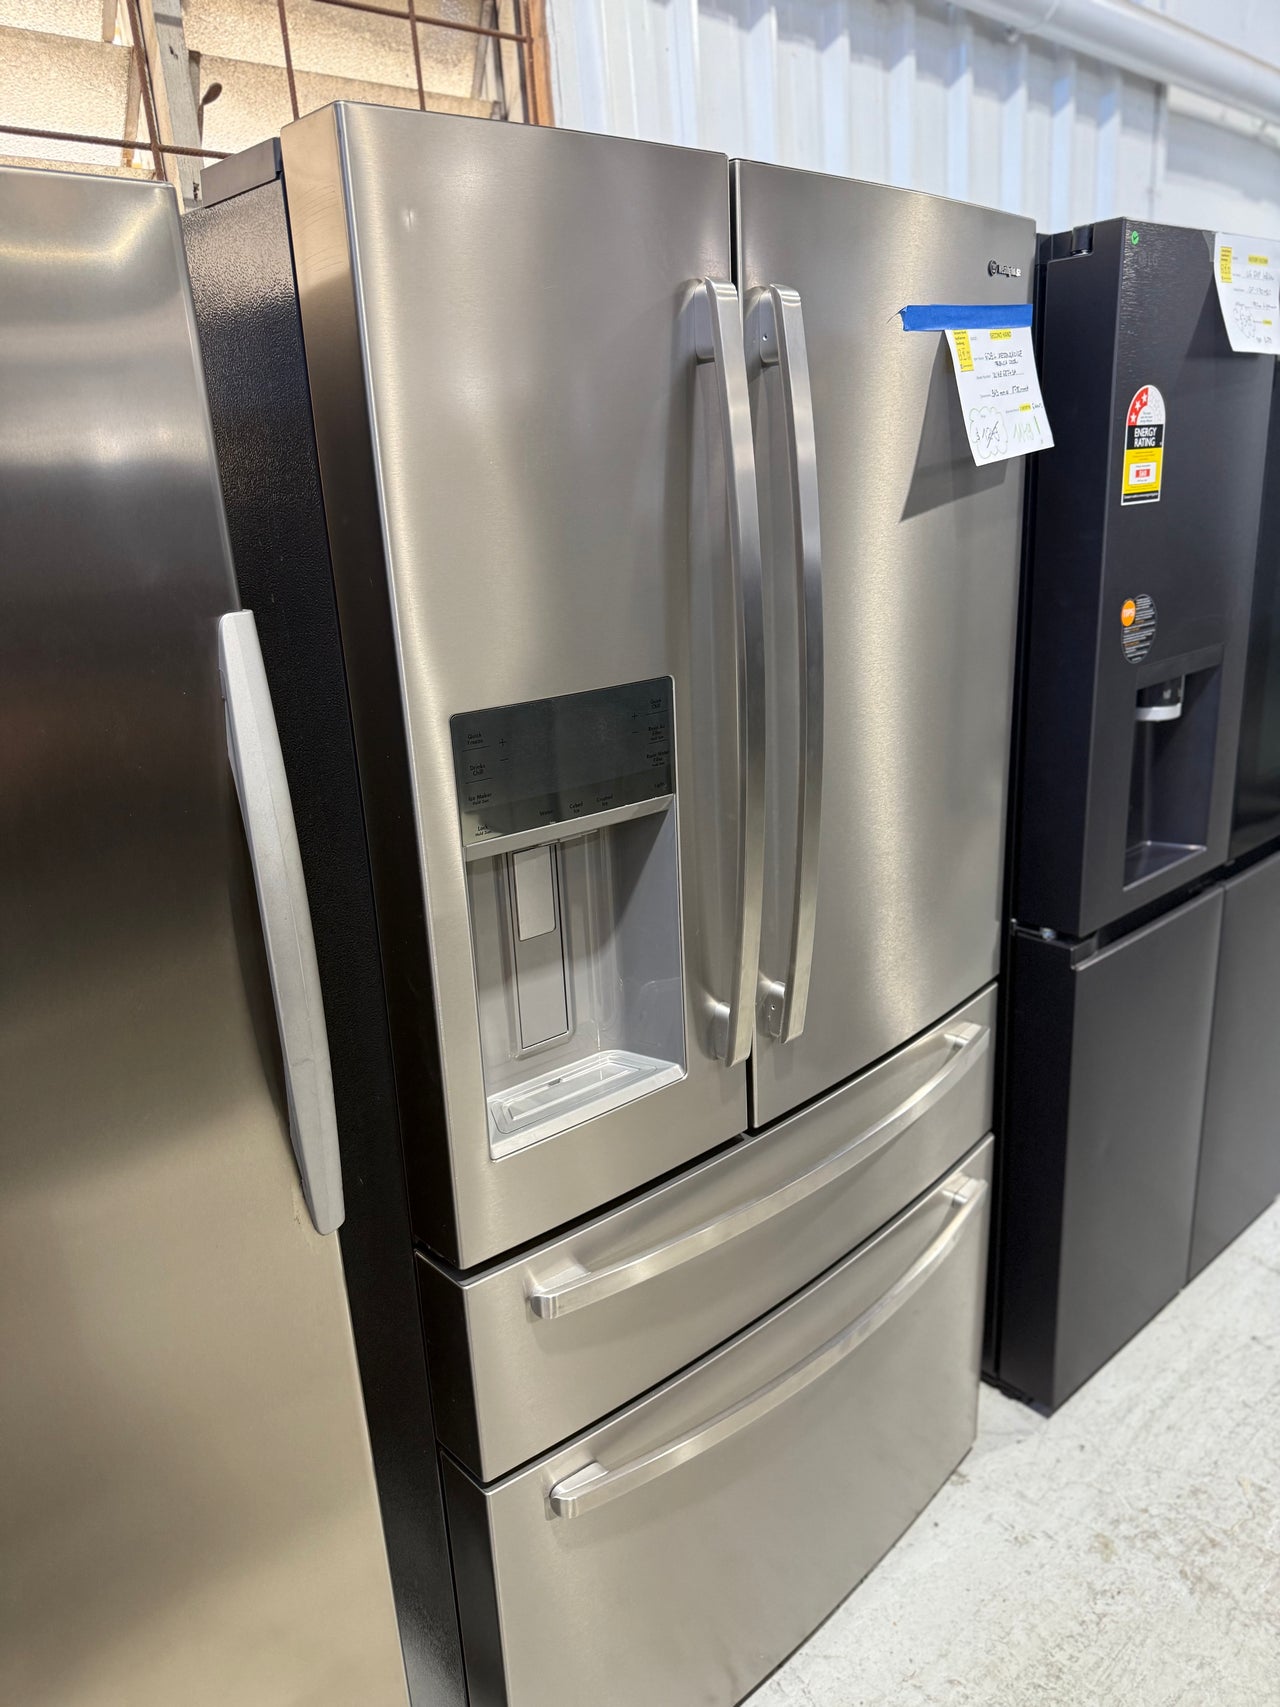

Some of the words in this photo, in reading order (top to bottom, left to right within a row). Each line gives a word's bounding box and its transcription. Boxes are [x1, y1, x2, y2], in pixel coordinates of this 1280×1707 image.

[1134, 427, 1157, 437] ENERGY
[1133, 437, 1156, 448] RATING
[467, 732, 481, 740] Quick
[469, 763, 485, 771] Drinks
[569, 801, 583, 809] Cubed
[477, 824, 488, 832] Lock
